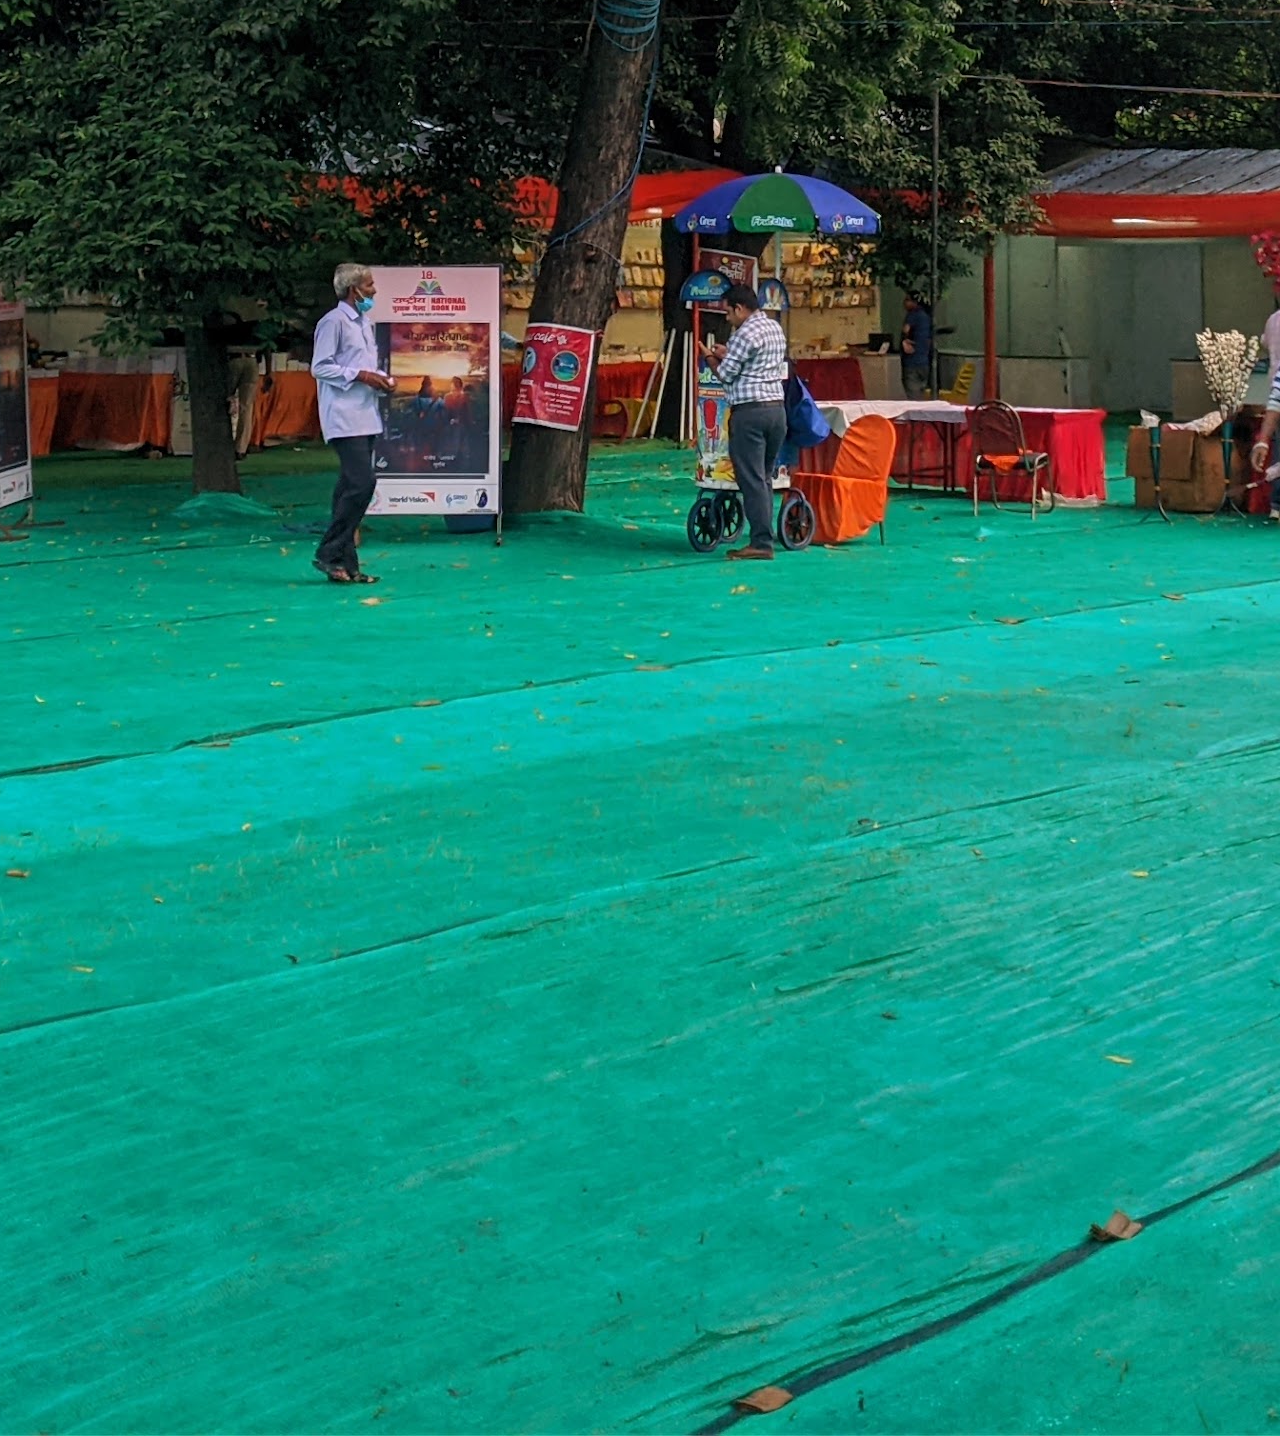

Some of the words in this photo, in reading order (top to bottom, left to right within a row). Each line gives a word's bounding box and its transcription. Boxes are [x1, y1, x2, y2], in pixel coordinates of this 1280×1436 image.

[430, 296, 466, 304] NATIONAL
[430, 304, 450, 312] BOOK
[452, 304, 466, 312] FAIR
